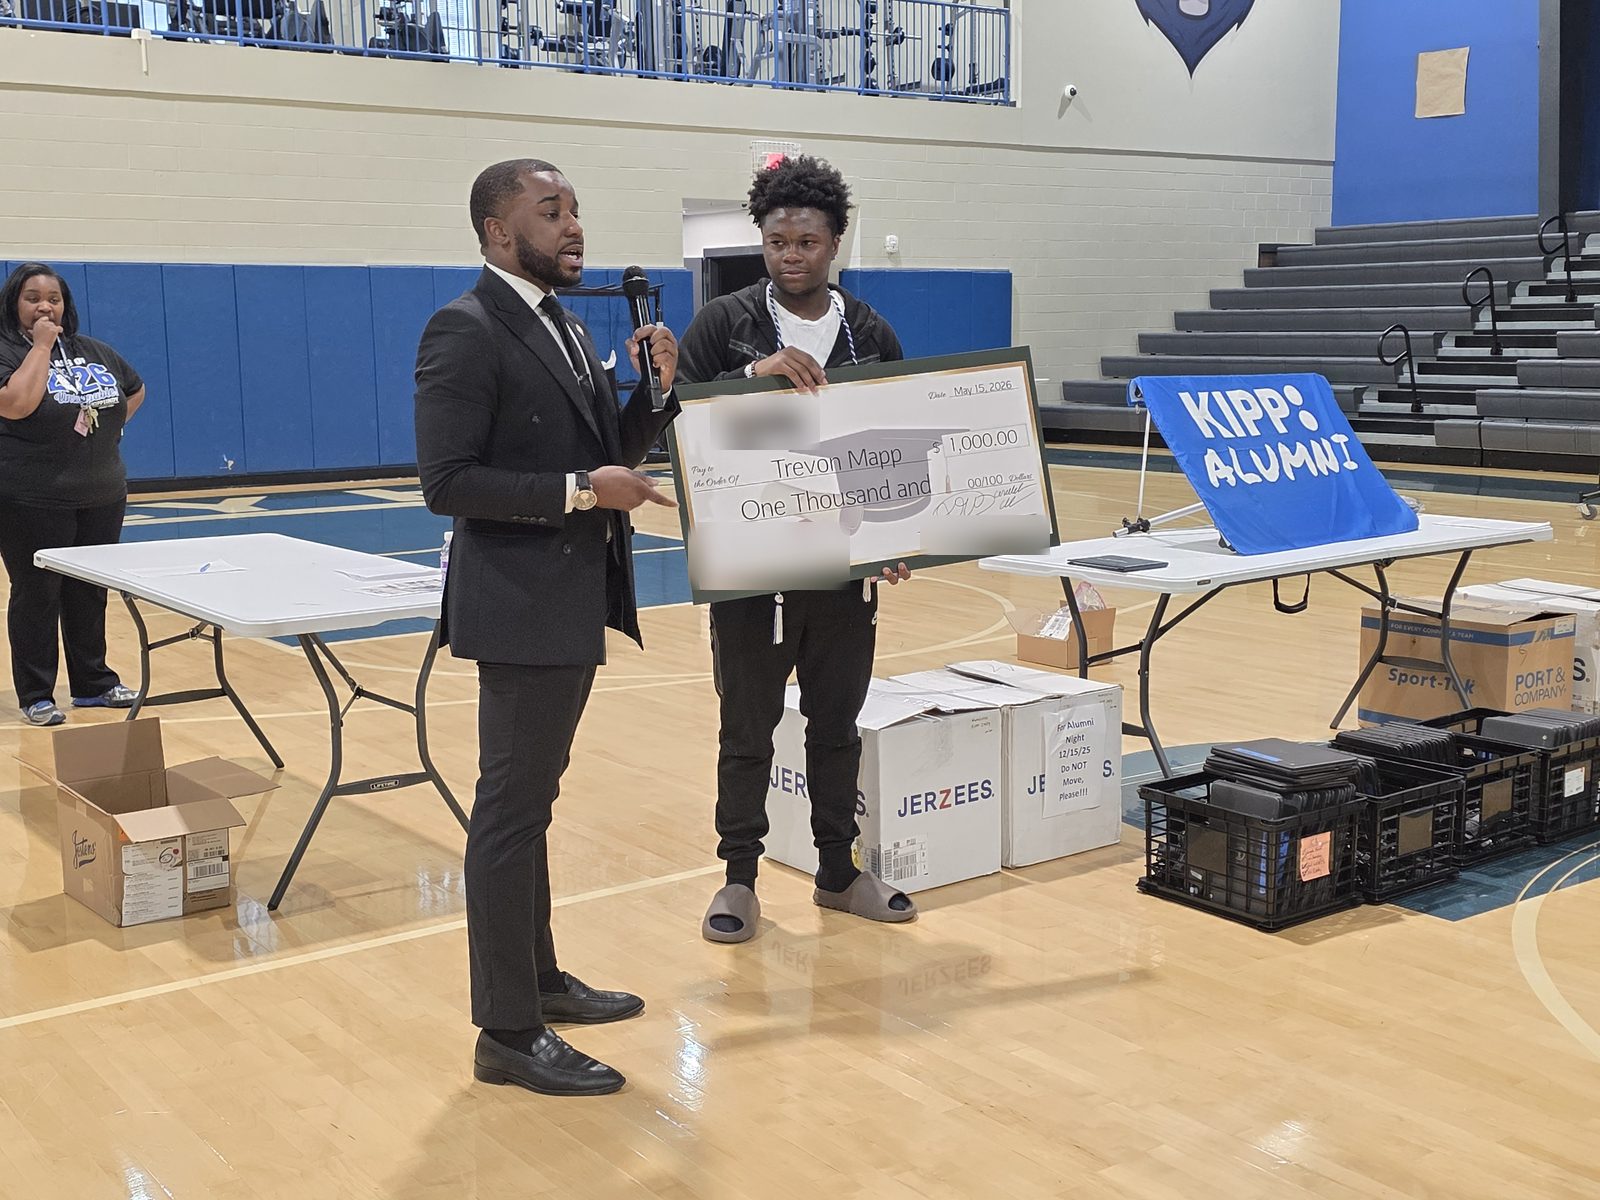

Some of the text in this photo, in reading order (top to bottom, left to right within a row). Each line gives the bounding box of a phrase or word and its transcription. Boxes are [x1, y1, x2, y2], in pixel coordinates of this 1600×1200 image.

[954, 386, 973, 397] May
[989, 380, 1013, 393] 2026
[950, 429, 1018, 455] 1,000.00
[770, 448, 902, 479] Trevon Mapp
[1204, 433, 1358, 488] ALUMNI
[967, 474, 1003, 489] 00/100
[741, 473, 931, 521] One Thousand and
[1388, 668, 1475, 694] Sport-Tk
[1515, 668, 1553, 691] PORT
[1555, 666, 1566, 683] &
[1515, 685, 1566, 706] COMPANY
[1057, 717, 1094, 733] For Alumni
[1065, 734, 1085, 744] Night
[1059, 746, 1091, 758] 12/15/25
[1061, 761, 1088, 773] Do NOT
[1063, 776, 1084, 787] Move,
[1059, 787, 1088, 801] Please!!!
